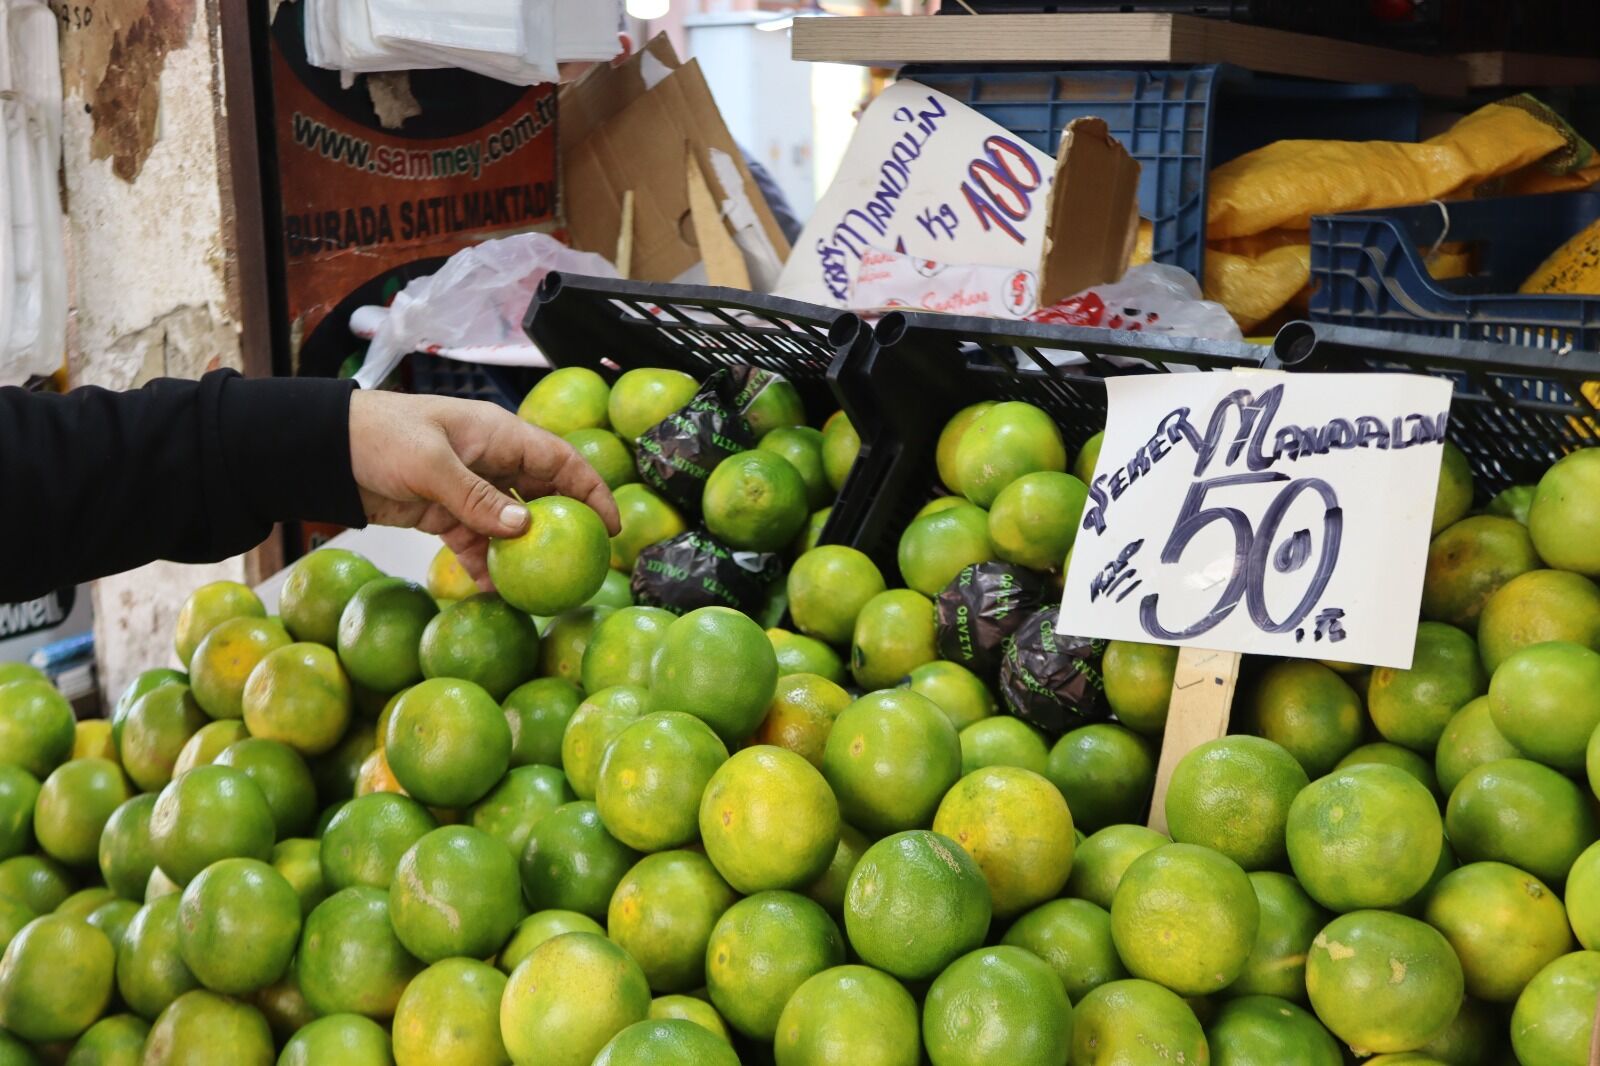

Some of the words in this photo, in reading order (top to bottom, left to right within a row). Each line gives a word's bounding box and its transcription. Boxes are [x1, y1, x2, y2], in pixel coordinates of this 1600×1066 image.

[285, 205, 394, 257] BURADA
[960, 135, 1042, 246] 100
[1140, 471, 1343, 640] 50
[957, 606, 973, 660] ORVITA
